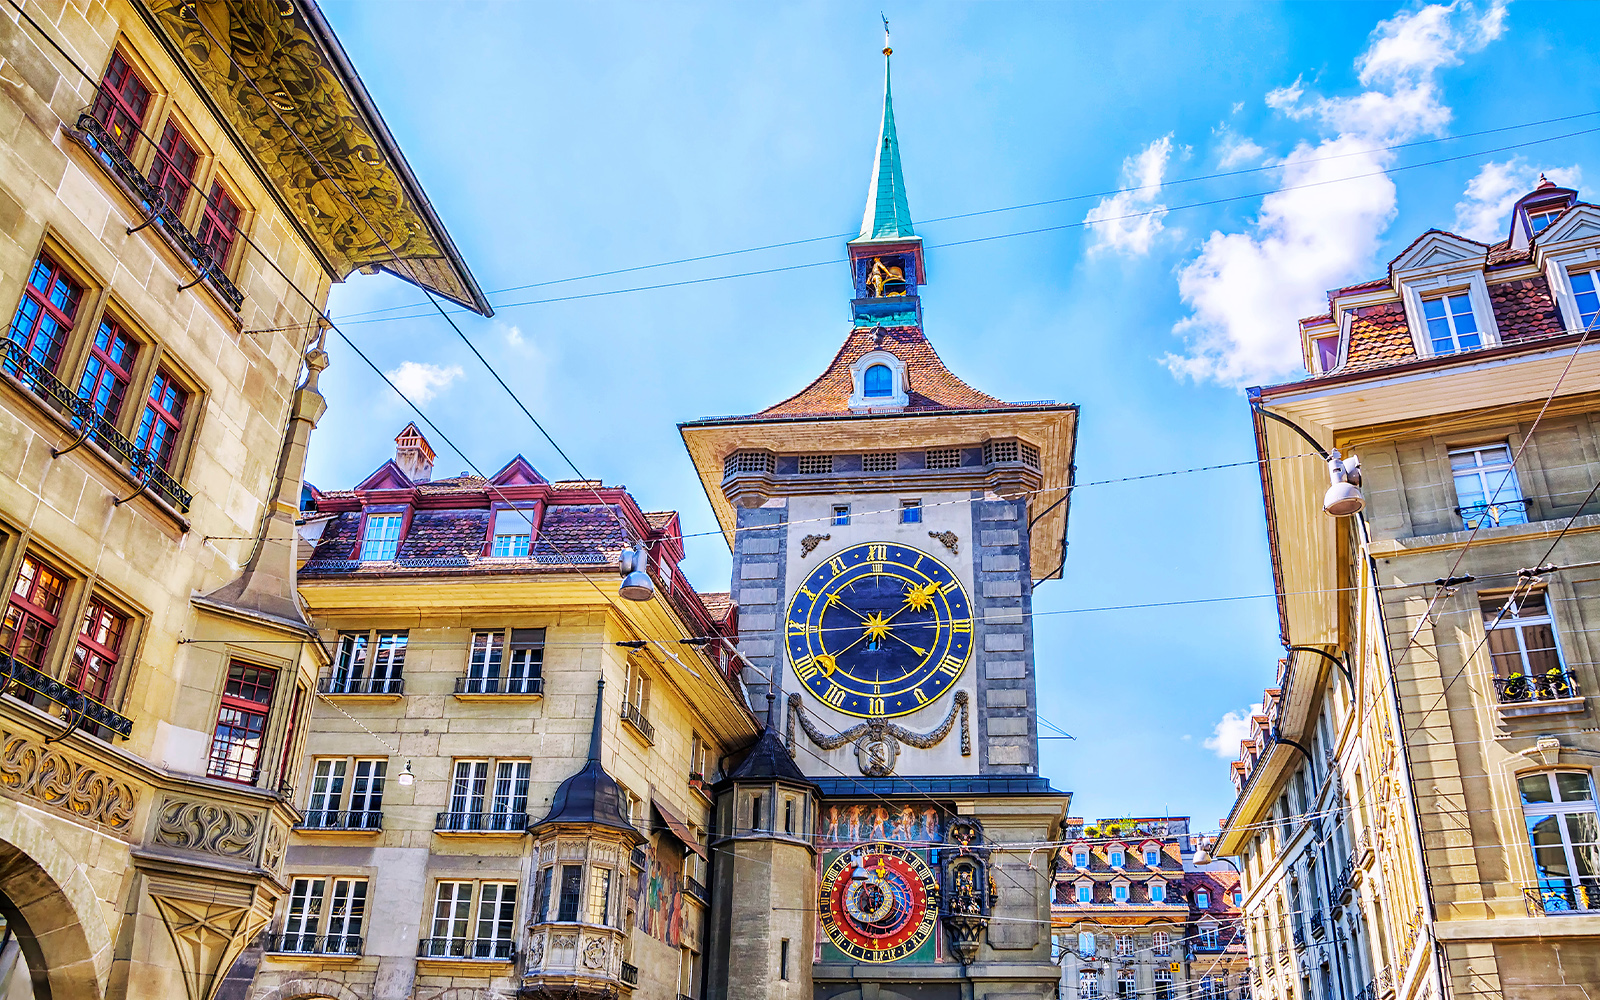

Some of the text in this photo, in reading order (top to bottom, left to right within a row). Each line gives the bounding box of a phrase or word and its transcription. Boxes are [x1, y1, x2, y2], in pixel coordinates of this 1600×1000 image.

[866, 545, 888, 561] XII
[829, 556, 847, 576] XI
[872, 563, 883, 573] IIII
[914, 555, 924, 568] I
[801, 585, 816, 601] X
[941, 579, 959, 595] II
[788, 619, 806, 637] IX
[952, 618, 971, 633] III
[795, 654, 818, 681] VIII
[939, 654, 964, 678] IIII
[823, 684, 846, 707] VII
